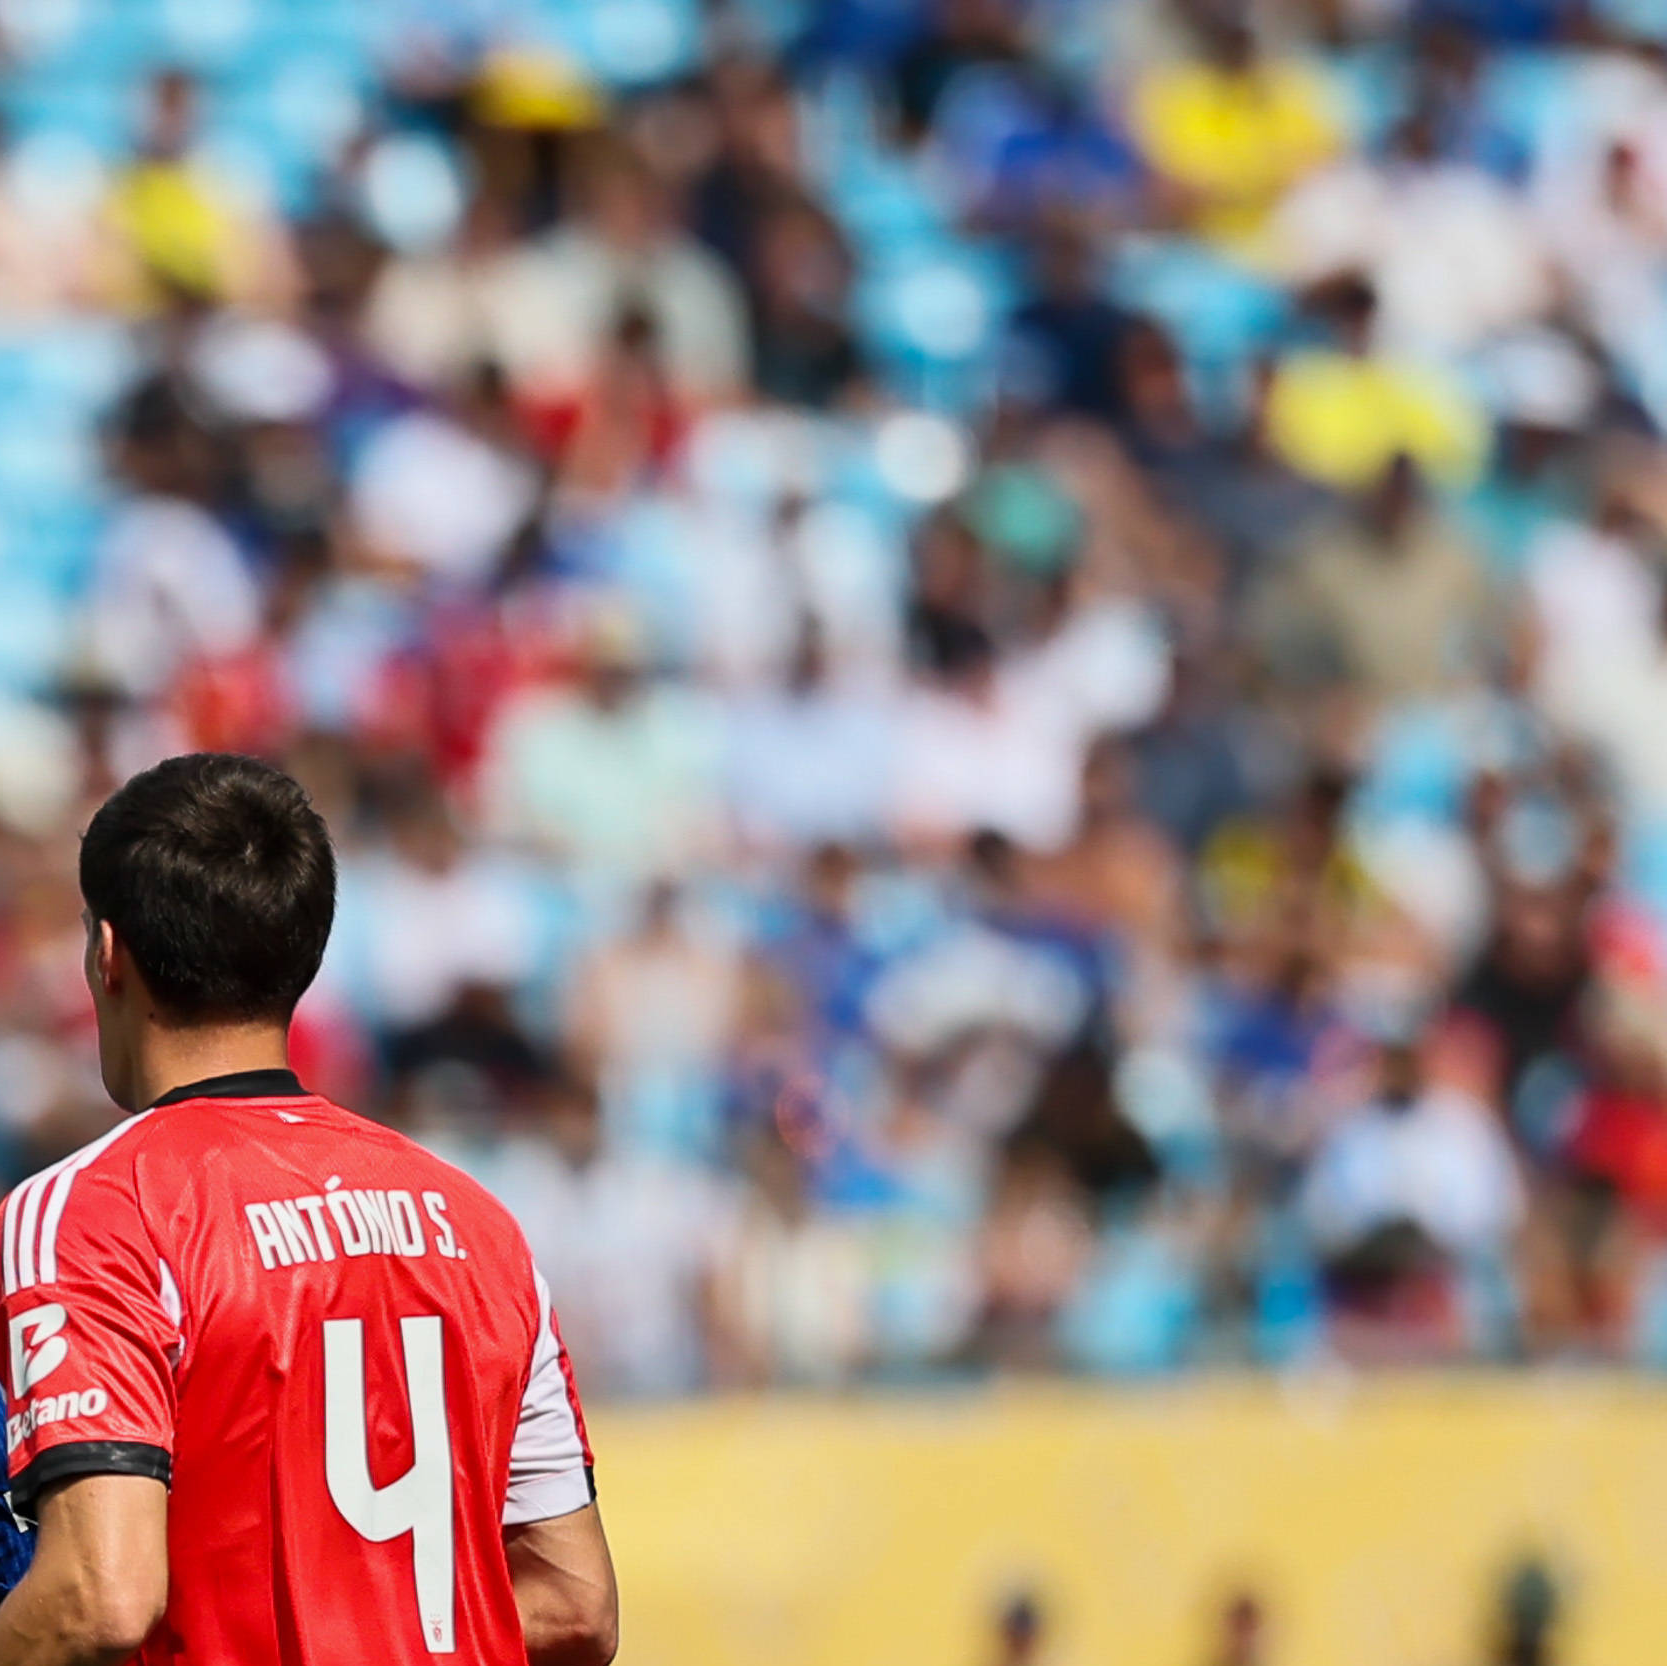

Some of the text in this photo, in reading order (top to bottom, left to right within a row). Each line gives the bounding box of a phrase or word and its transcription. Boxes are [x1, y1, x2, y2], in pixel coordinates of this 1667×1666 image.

[244, 1174, 468, 1270] ANTÓNIO S.
[6, 1387, 108, 1455] Betano
[323, 1315, 455, 1653] 4
